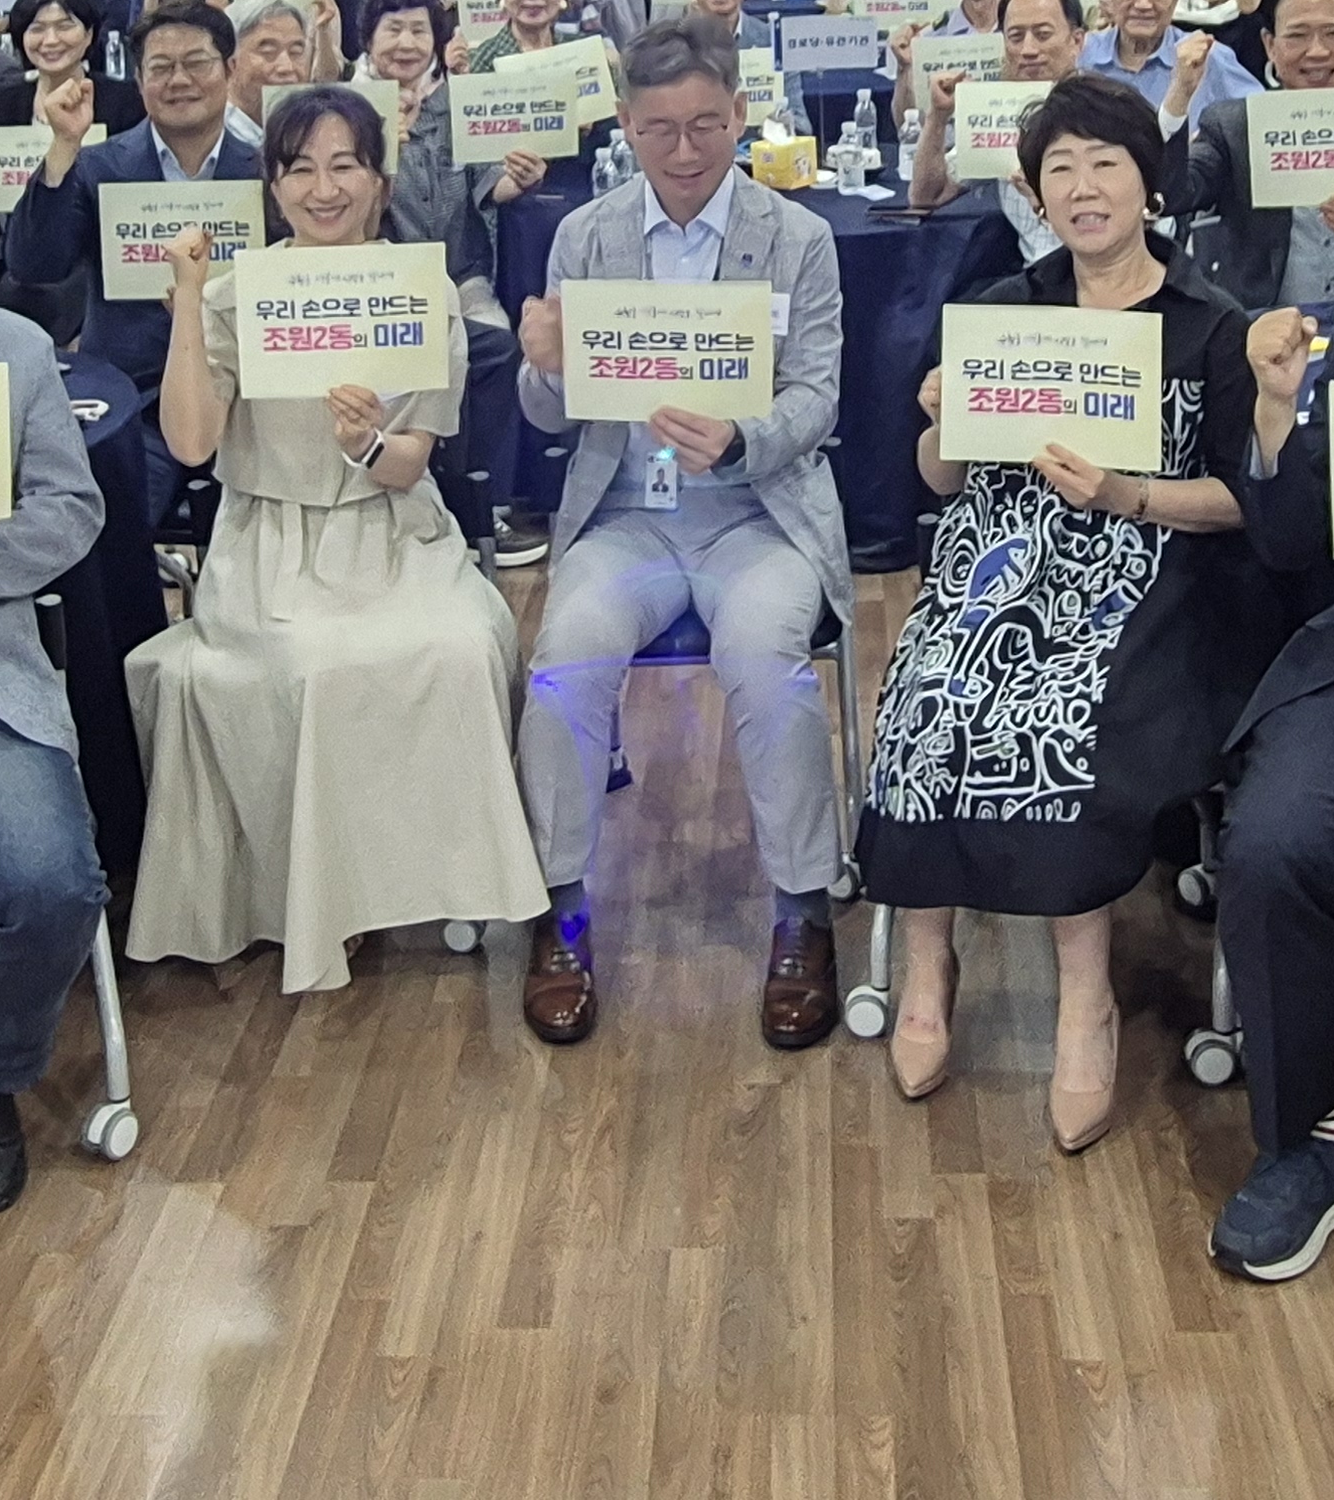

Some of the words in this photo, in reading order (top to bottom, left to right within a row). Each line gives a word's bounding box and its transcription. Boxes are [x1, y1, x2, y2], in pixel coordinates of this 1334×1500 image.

[463, 104, 487, 117] 우리
[490, 102, 526, 116] 손으로
[530, 100, 566, 114] 만드는
[1264, 130, 1297, 147] 우리
[116, 223, 147, 240] 우리
[256, 300, 295, 321] 우리
[302, 298, 362, 319] 손으로
[367, 295, 429, 317] 만드는
[263, 324, 368, 352] 조원2동의
[374, 321, 423, 347] 미래
[582, 330, 622, 350] 우리
[628, 331, 688, 351] 손으로
[694, 333, 755, 352] 만드는
[589, 356, 694, 380] 조원2동의
[699, 356, 748, 380] 미래
[962, 359, 1004, 380] 우리
[1011, 359, 1073, 382] 손으로
[1079, 363, 1142, 389] 만드는
[968, 387, 1077, 415] 조원2동의
[1084, 392, 1135, 421] 미래
